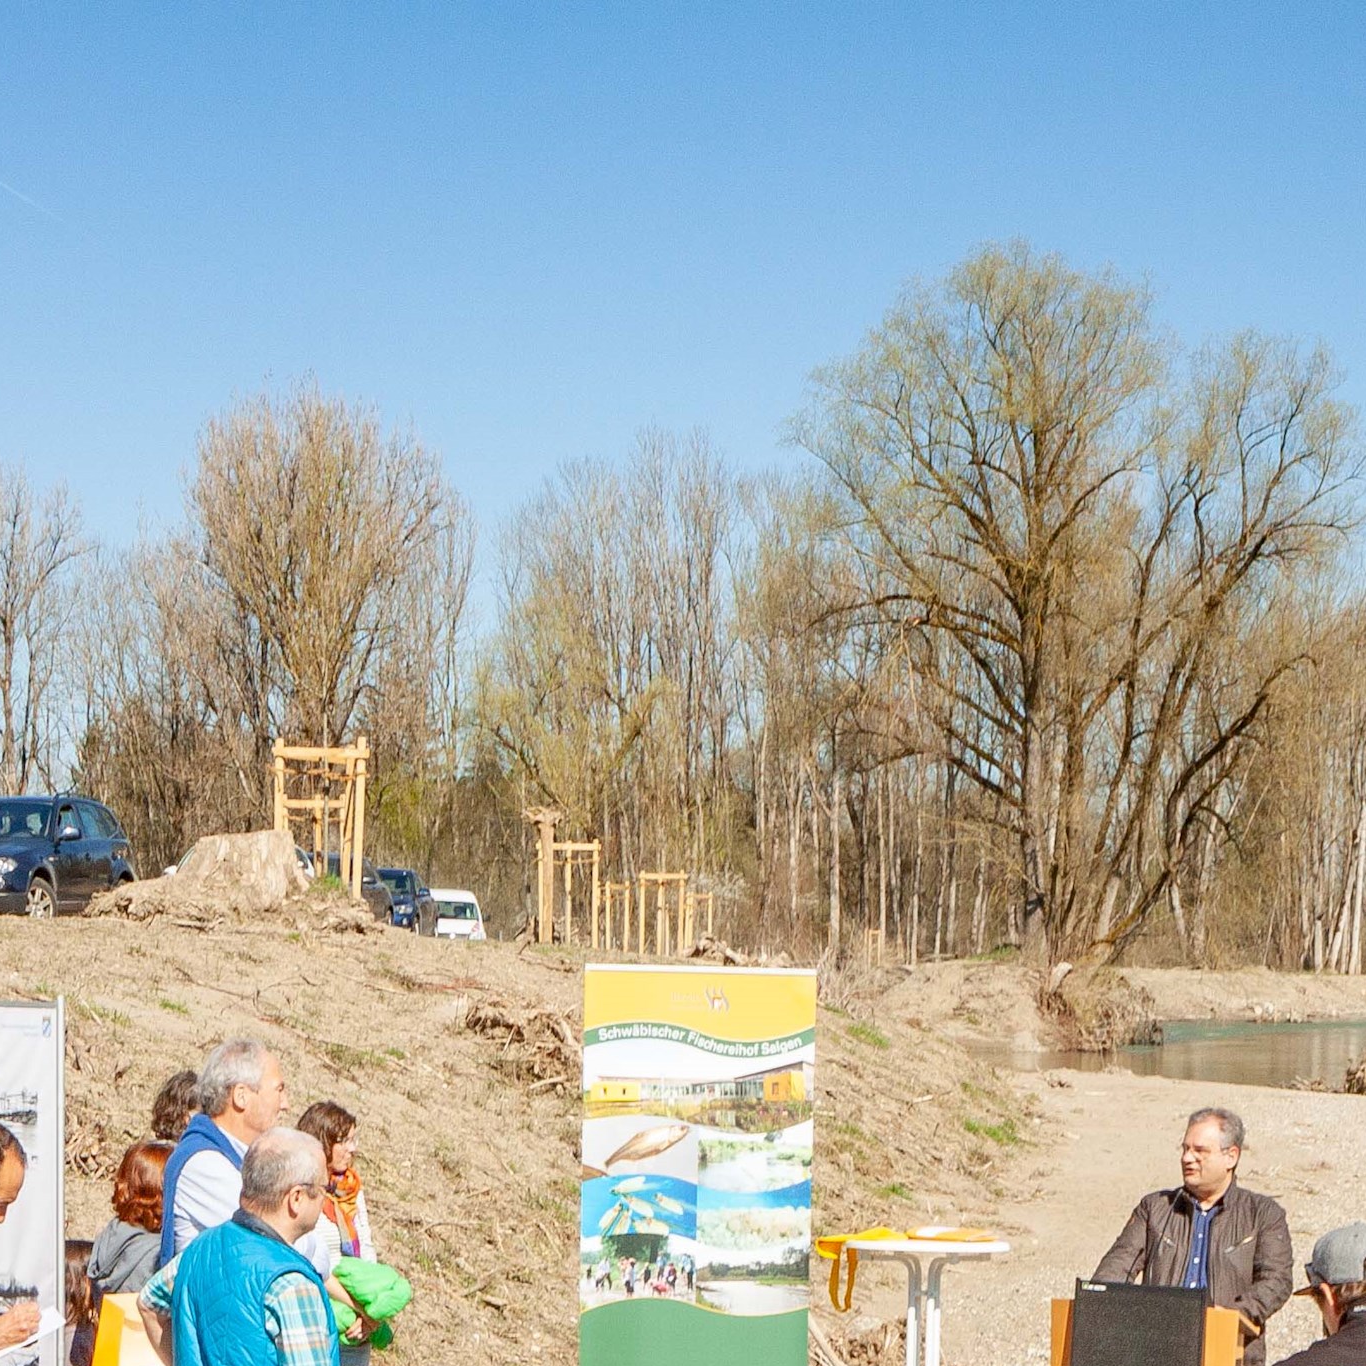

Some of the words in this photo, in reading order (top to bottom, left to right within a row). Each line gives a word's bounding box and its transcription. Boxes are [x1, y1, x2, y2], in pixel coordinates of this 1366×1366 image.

[598, 1024, 686, 1042] Schwäbischer
[687, 1031, 760, 1057] Fischereihof
[761, 1036, 803, 1056] Salgen
